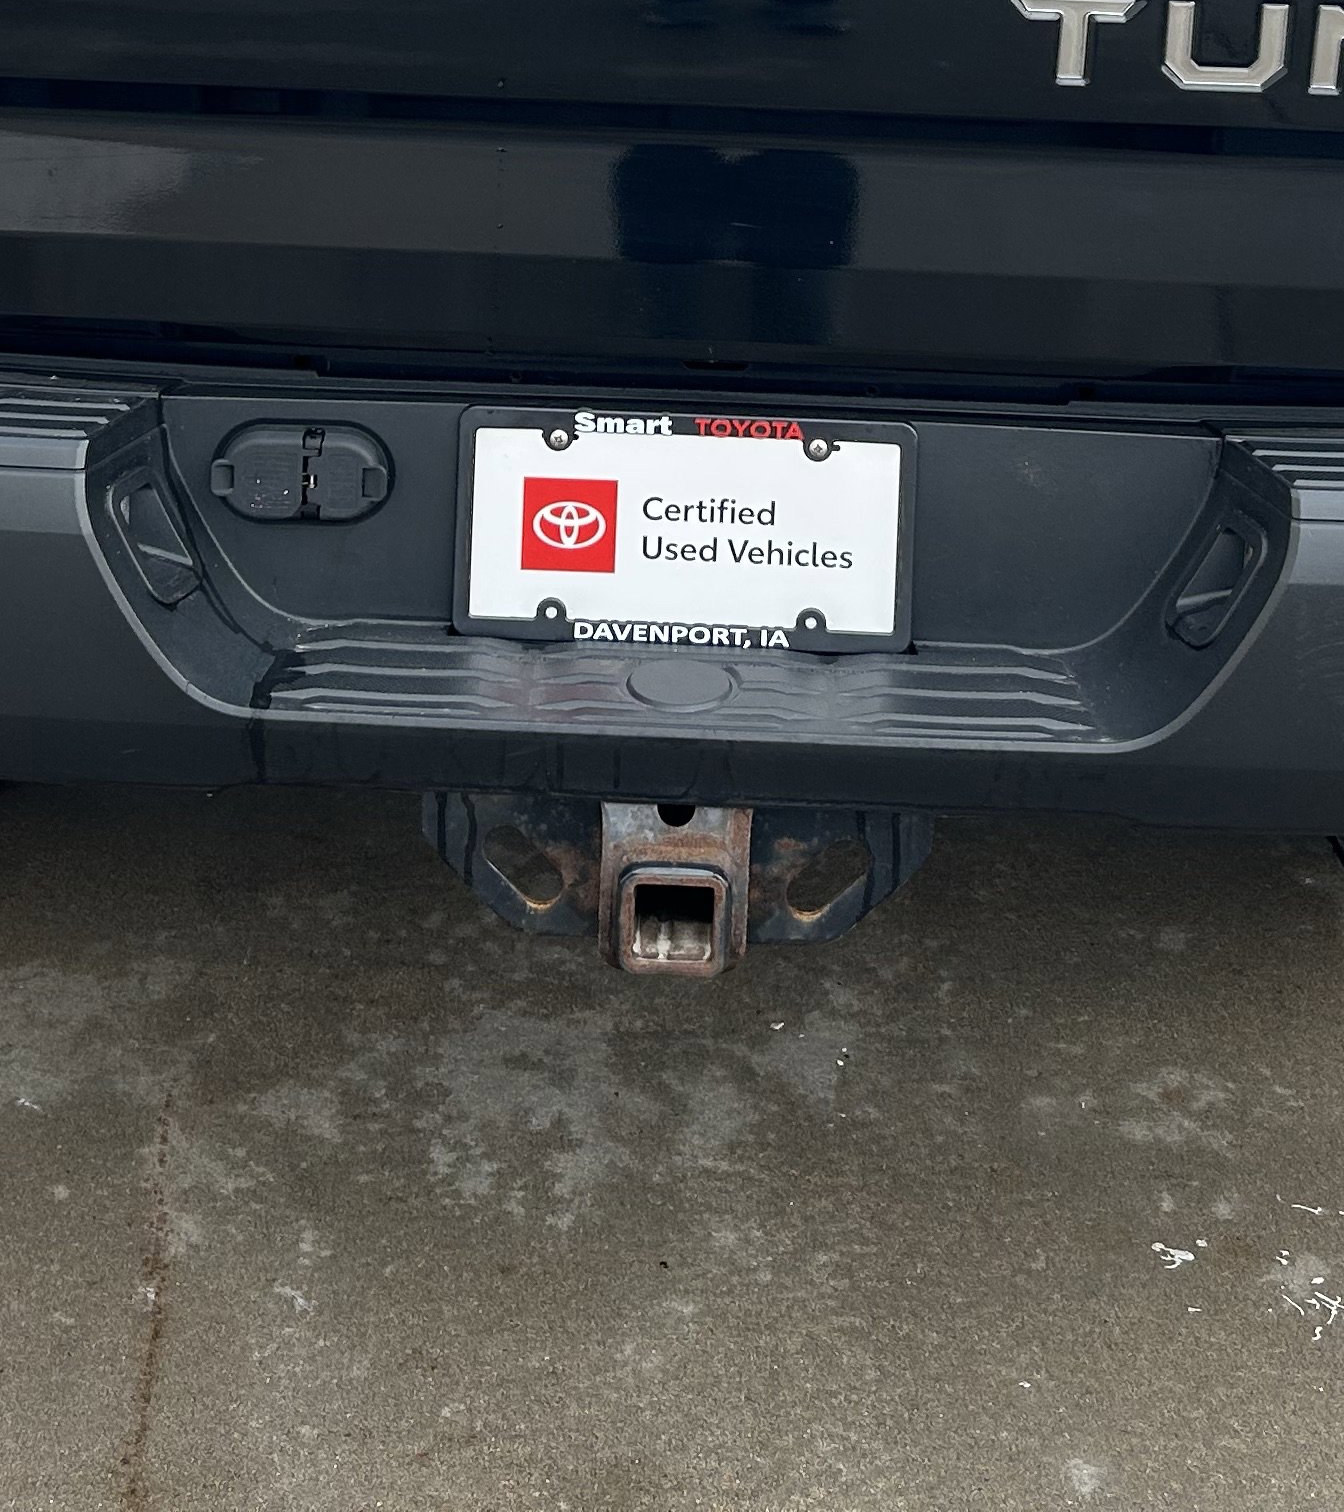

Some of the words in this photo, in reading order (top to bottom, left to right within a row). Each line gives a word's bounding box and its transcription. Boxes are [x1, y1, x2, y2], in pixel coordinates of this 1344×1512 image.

[574, 411, 673, 436] Smart
[695, 417, 805, 441] TOYOTA
[642, 496, 776, 526] Certified
[642, 535, 718, 563] Used
[728, 539, 854, 569] Vehicles
[573, 621, 751, 649] DAVENPORT,
[759, 628, 790, 649] IA
